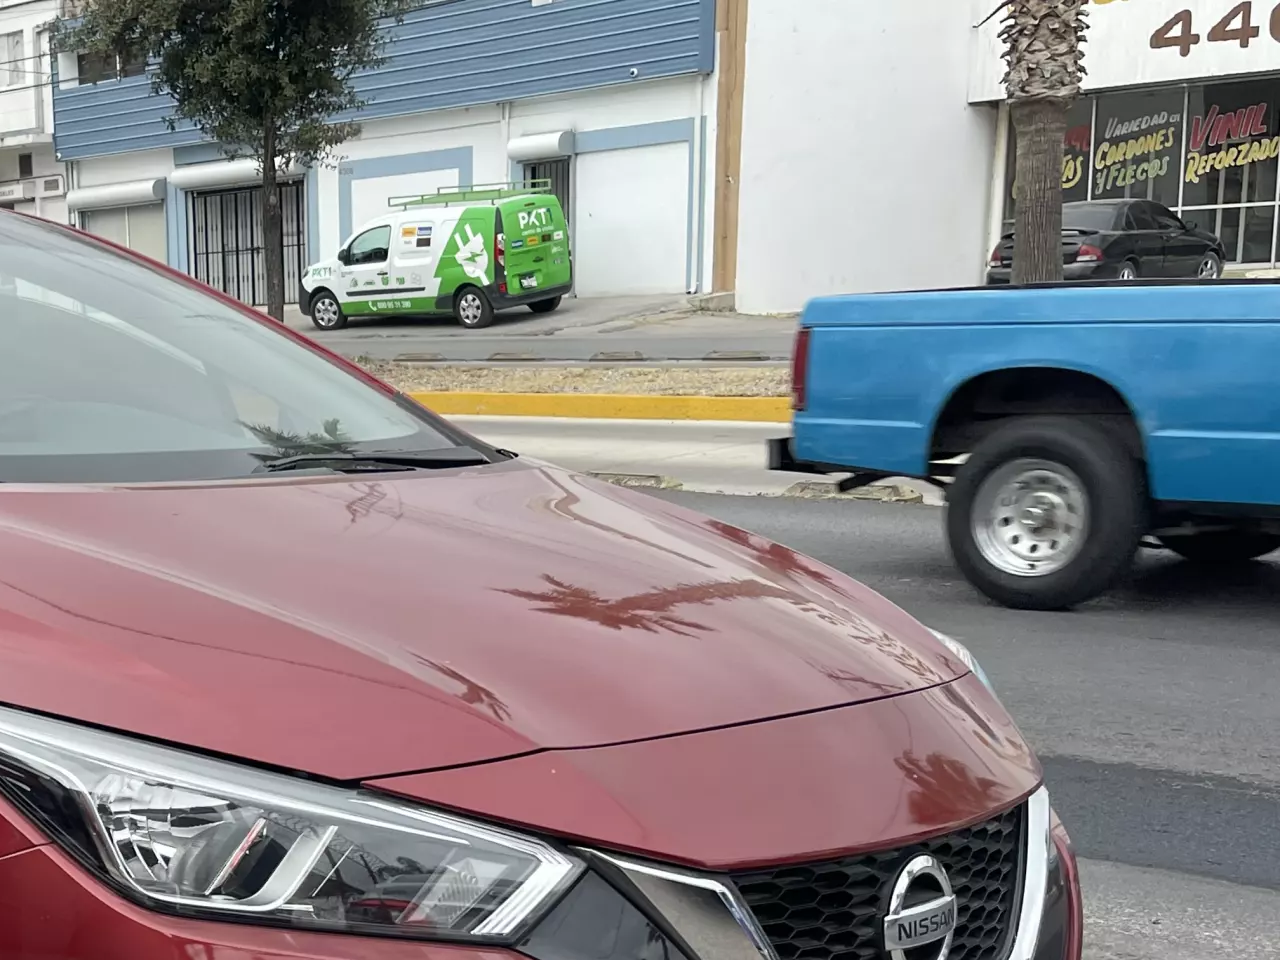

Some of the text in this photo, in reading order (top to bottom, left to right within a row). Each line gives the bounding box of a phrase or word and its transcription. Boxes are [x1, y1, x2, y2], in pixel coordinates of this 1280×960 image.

[1150, 1, 1280, 57] 44
[1105, 111, 1167, 139] VARIEDAD
[1190, 103, 1267, 151] VINIL
[1095, 127, 1175, 170] CORDONES
[1185, 136, 1280, 184] REFORZADO
[1107, 156, 1170, 187] FLECOS
[898, 908, 954, 941] NISSAN
